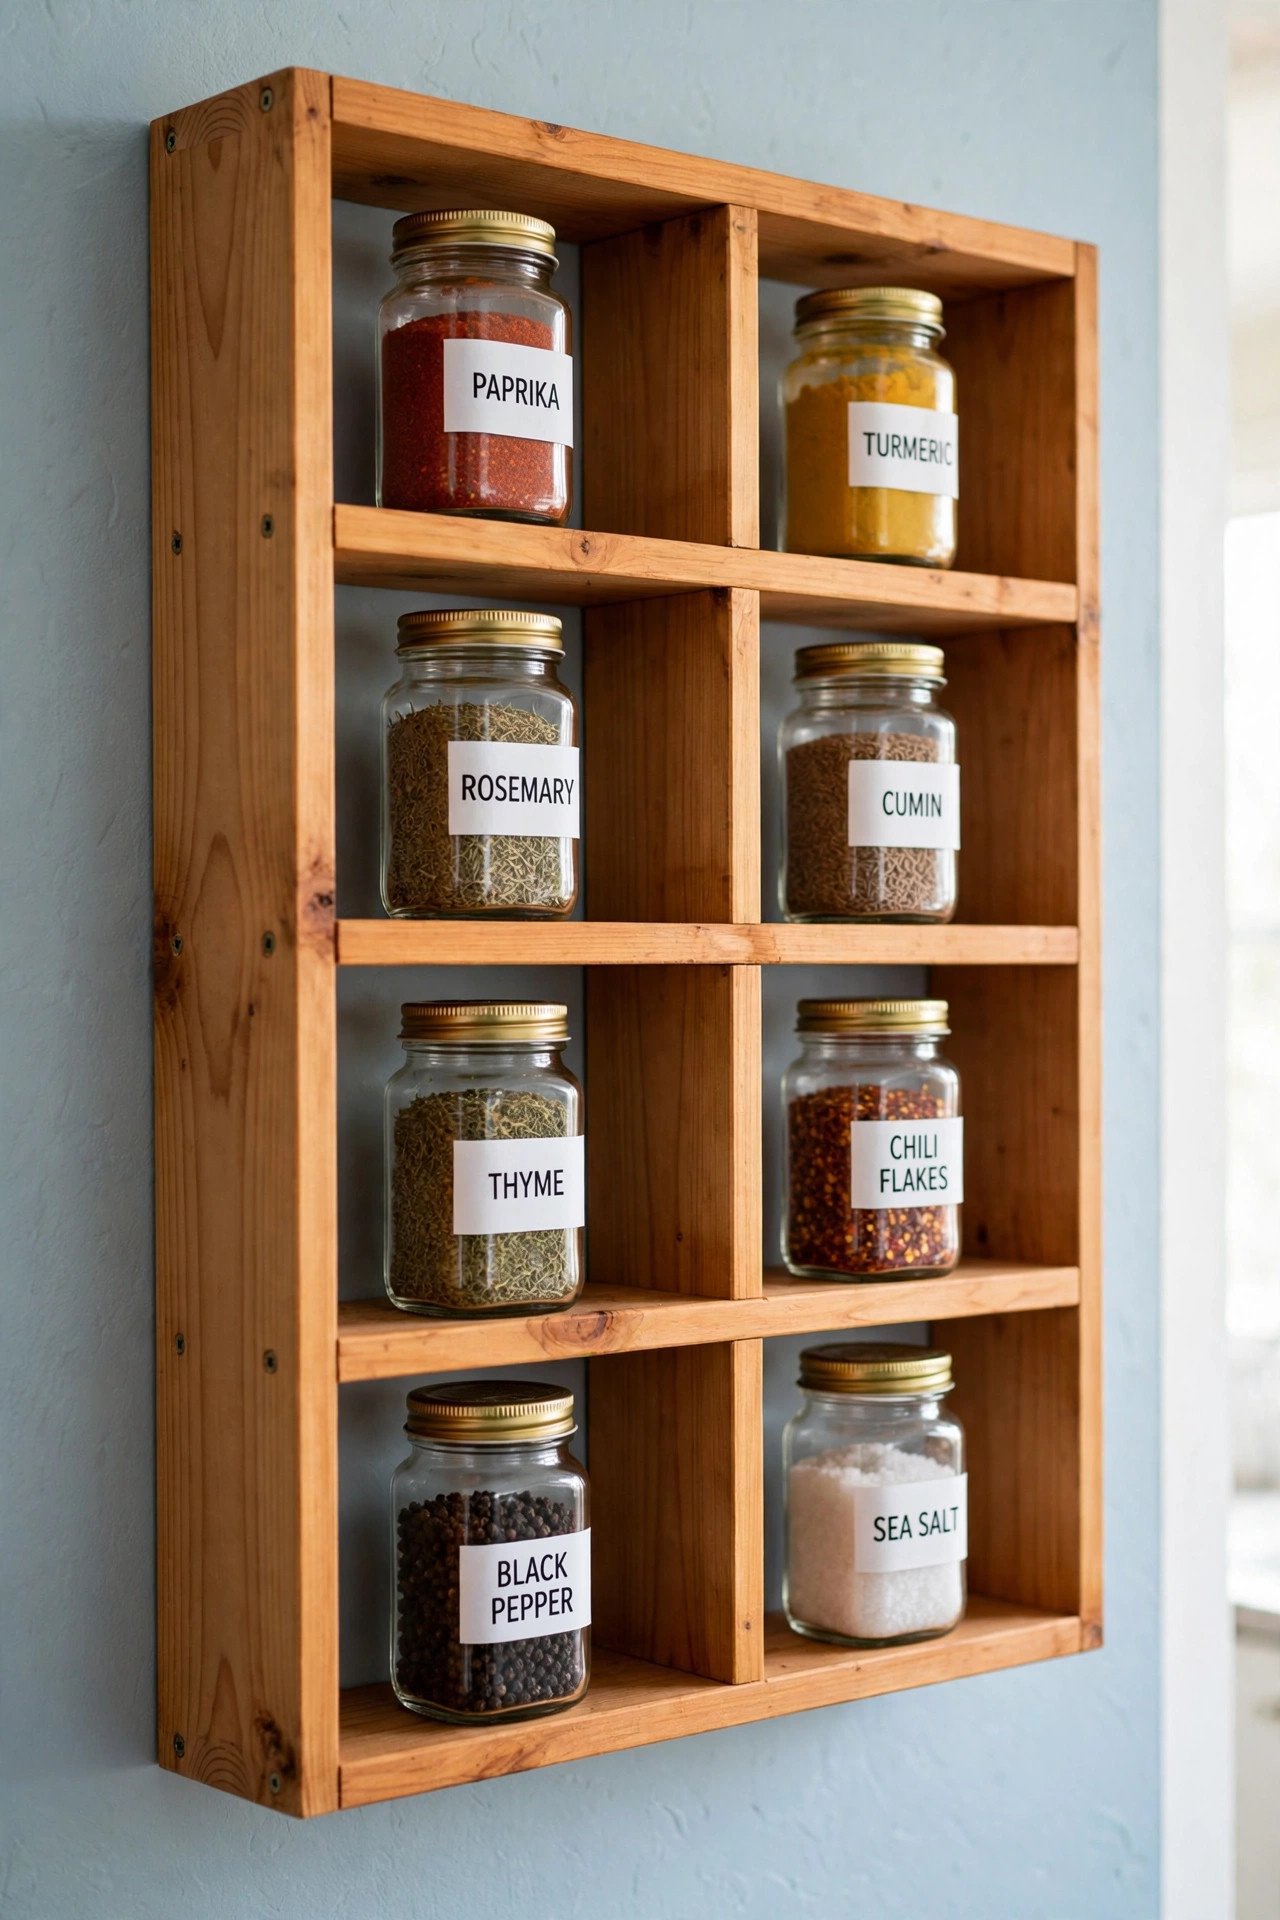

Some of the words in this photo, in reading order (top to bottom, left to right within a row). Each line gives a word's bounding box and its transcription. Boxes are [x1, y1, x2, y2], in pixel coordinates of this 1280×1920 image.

[473, 371, 560, 410] PAPRIKA
[863, 431, 953, 466] TURMERIC
[461, 773, 575, 805] ROSEMARY
[882, 790, 942, 818] CUMIN
[890, 1134, 937, 1160] CHILI
[487, 1169, 565, 1201] THYME
[880, 1165, 948, 1193] FLAKES
[873, 1514, 913, 1543] SEA
[918, 1506, 959, 1537] SALT
[497, 1551, 569, 1588] BLACK
[491, 1586, 574, 1625] PEPPER
